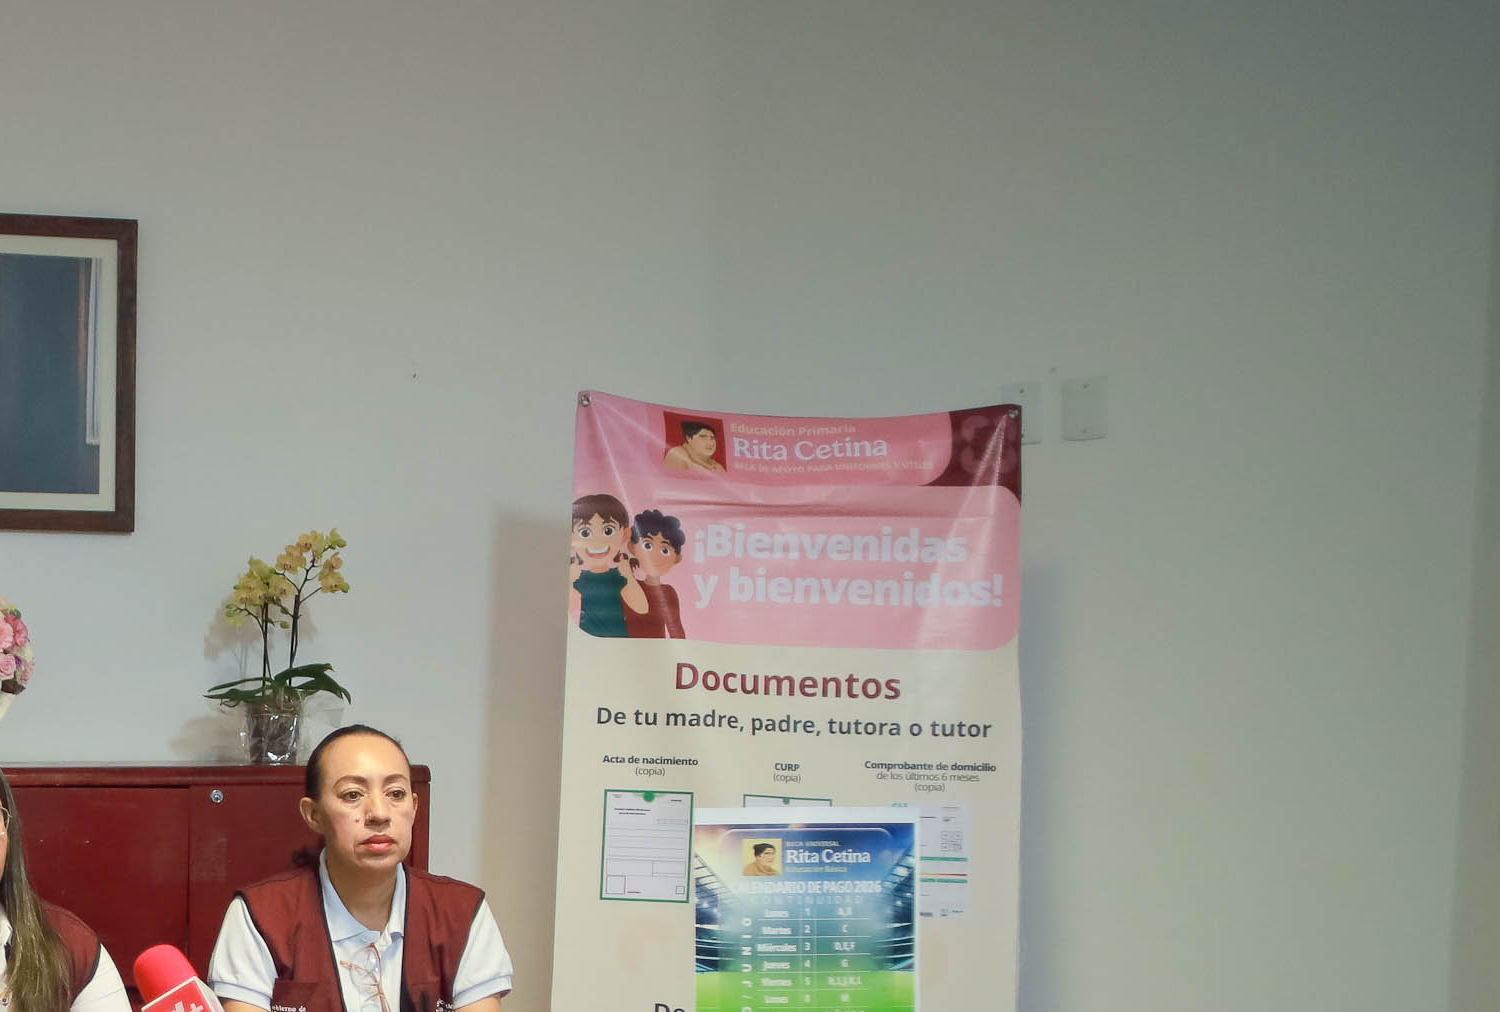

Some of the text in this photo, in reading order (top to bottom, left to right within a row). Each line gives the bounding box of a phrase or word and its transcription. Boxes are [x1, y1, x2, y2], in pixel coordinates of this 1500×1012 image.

[732, 437, 888, 461] Rita Cetina
[693, 524, 967, 564] ¡Bienvenidas
[693, 567, 1004, 608] y bienvenidos!
[675, 662, 901, 701] Documentos
[596, 707, 992, 739] De tu madre, padre, tutora o tutor
[603, 755, 698, 766] Acta de nacimiento
[635, 766, 666, 777] (copia)
[774, 762, 800, 773] CURP
[865, 761, 996, 772] Comprobante de domicilio
[773, 772, 801, 784] (copia)
[877, 772, 980, 782] de los últimos 6 meses
[915, 783, 945, 792] (copia)
[786, 848, 871, 864] Rita Cetina
[854, 880, 882, 893] 2026
[804, 925, 811, 934] 2
[804, 942, 811, 951] 3
[741, 917, 752, 988] JUNIO
[804, 960, 811, 968] 4
